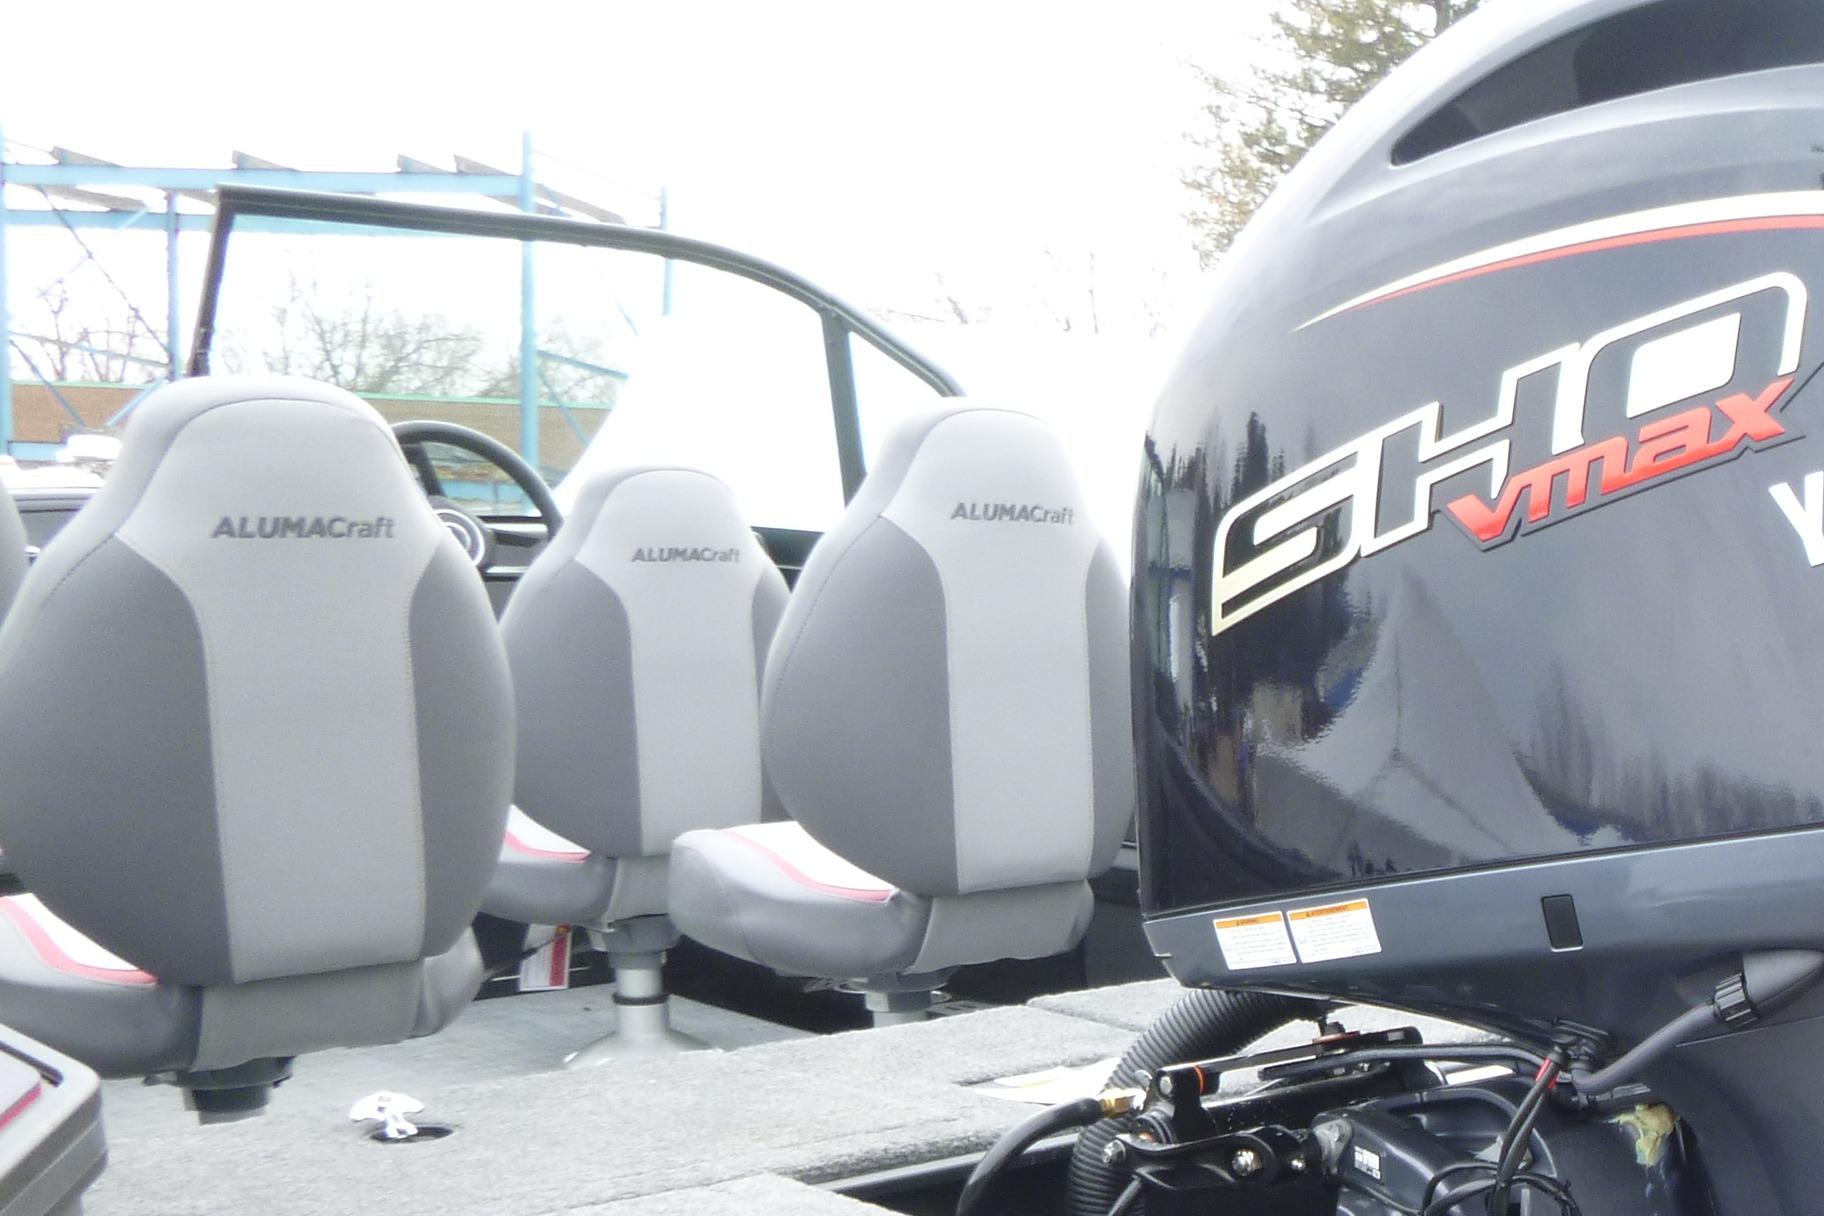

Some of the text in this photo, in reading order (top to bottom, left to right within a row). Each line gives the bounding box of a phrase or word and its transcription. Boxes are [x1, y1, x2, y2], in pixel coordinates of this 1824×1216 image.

[1211, 270, 1808, 637] SHO
[950, 502, 1074, 525] ALUMACraft
[211, 515, 396, 540] ALUMACraft
